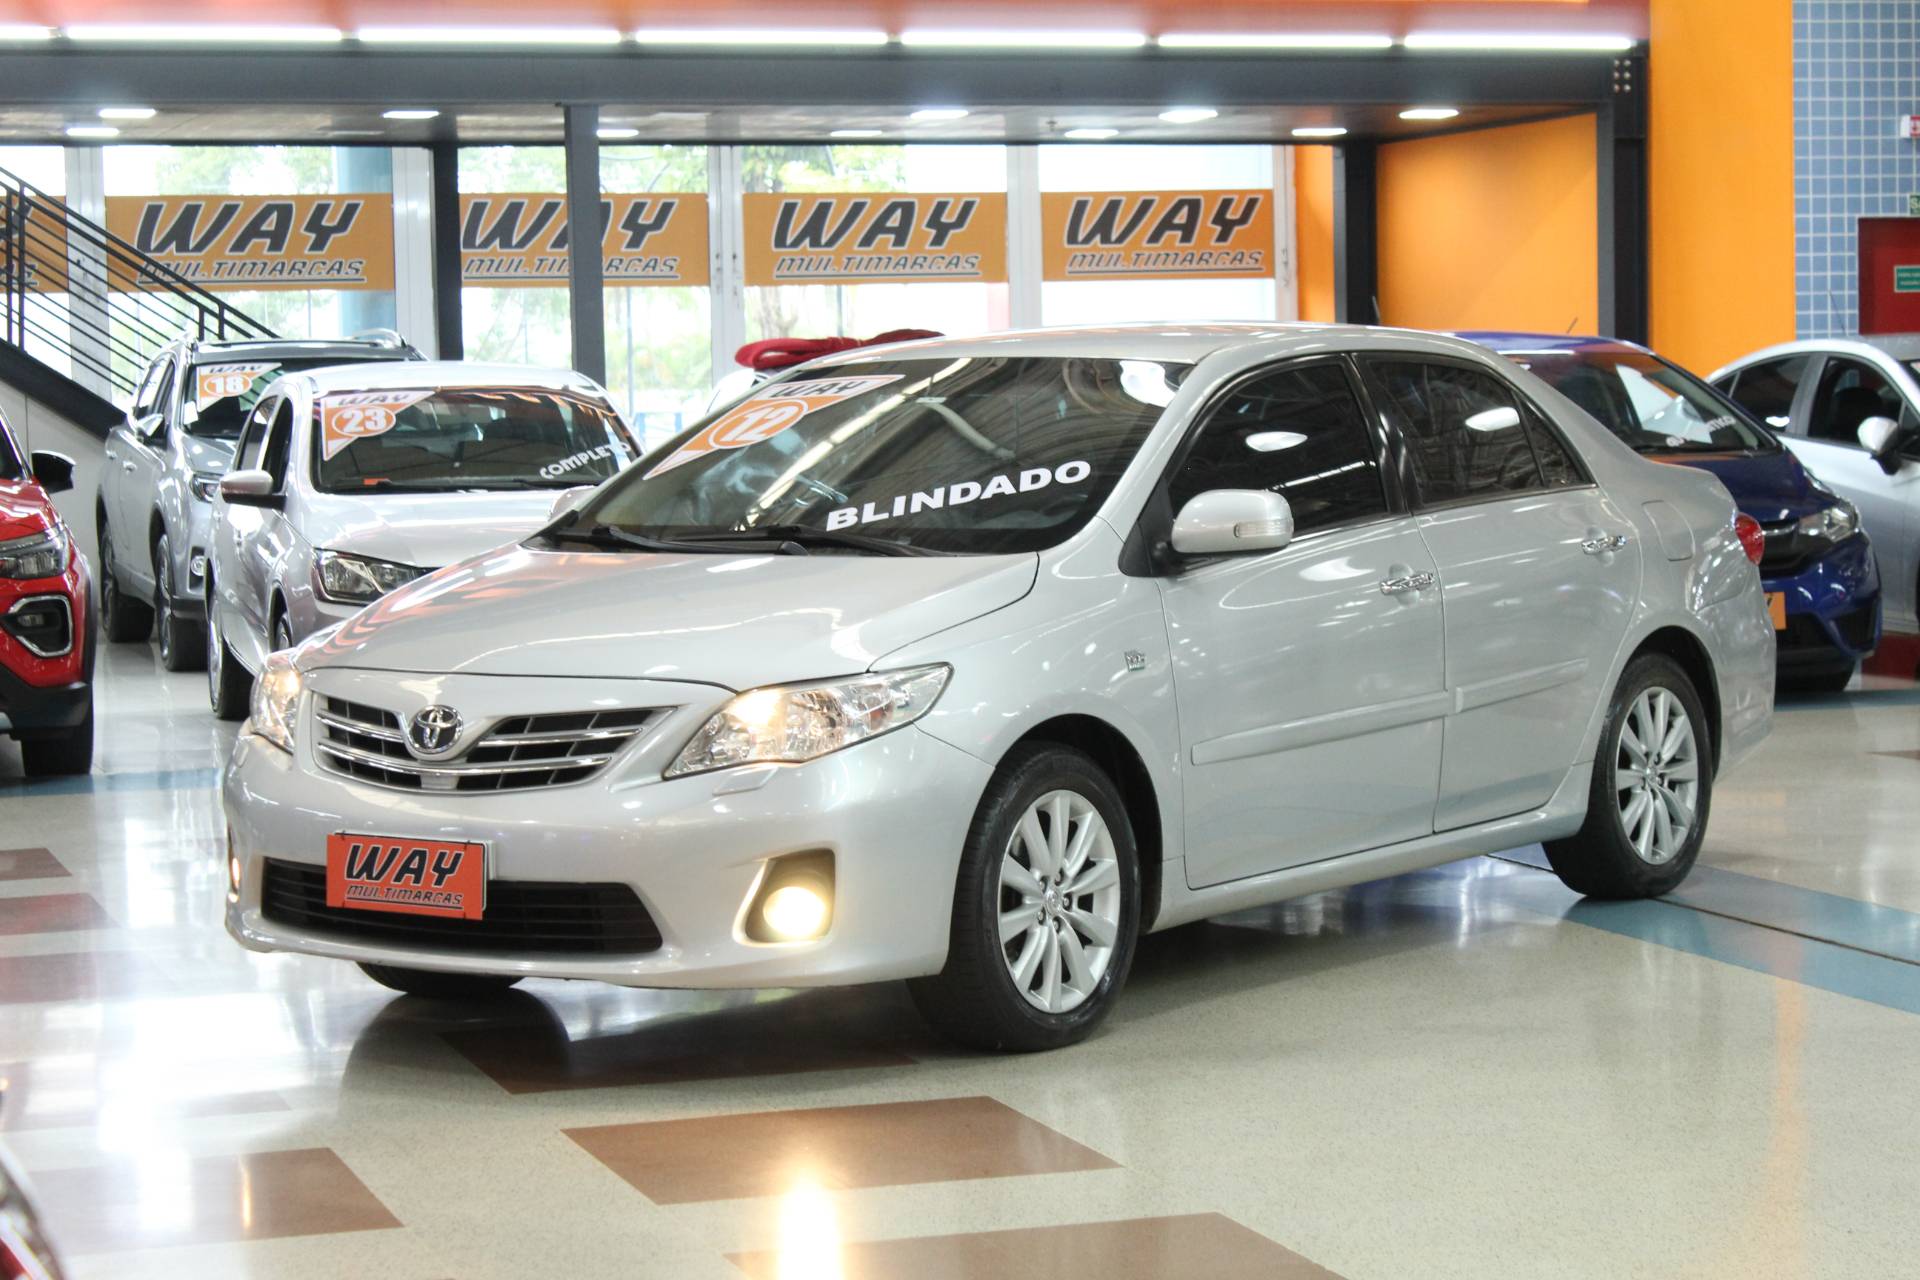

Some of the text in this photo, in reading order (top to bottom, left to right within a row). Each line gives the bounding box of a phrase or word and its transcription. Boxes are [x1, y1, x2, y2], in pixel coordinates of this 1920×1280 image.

[135, 201, 363, 256] WAY
[772, 198, 980, 251] WAY
[1064, 195, 1263, 247] WAY
[776, 254, 981, 273] MULTIMARCAS
[1067, 250, 1264, 269] MULTIMARCAS
[210, 375, 245, 394] 18
[771, 380, 869, 399] WAY
[341, 408, 387, 433] 23
[719, 404, 801, 443] 12
[826, 460, 1091, 531] BLINDADO
[344, 844, 464, 888] WAY
[346, 884, 463, 905] MULTIMARCAS
